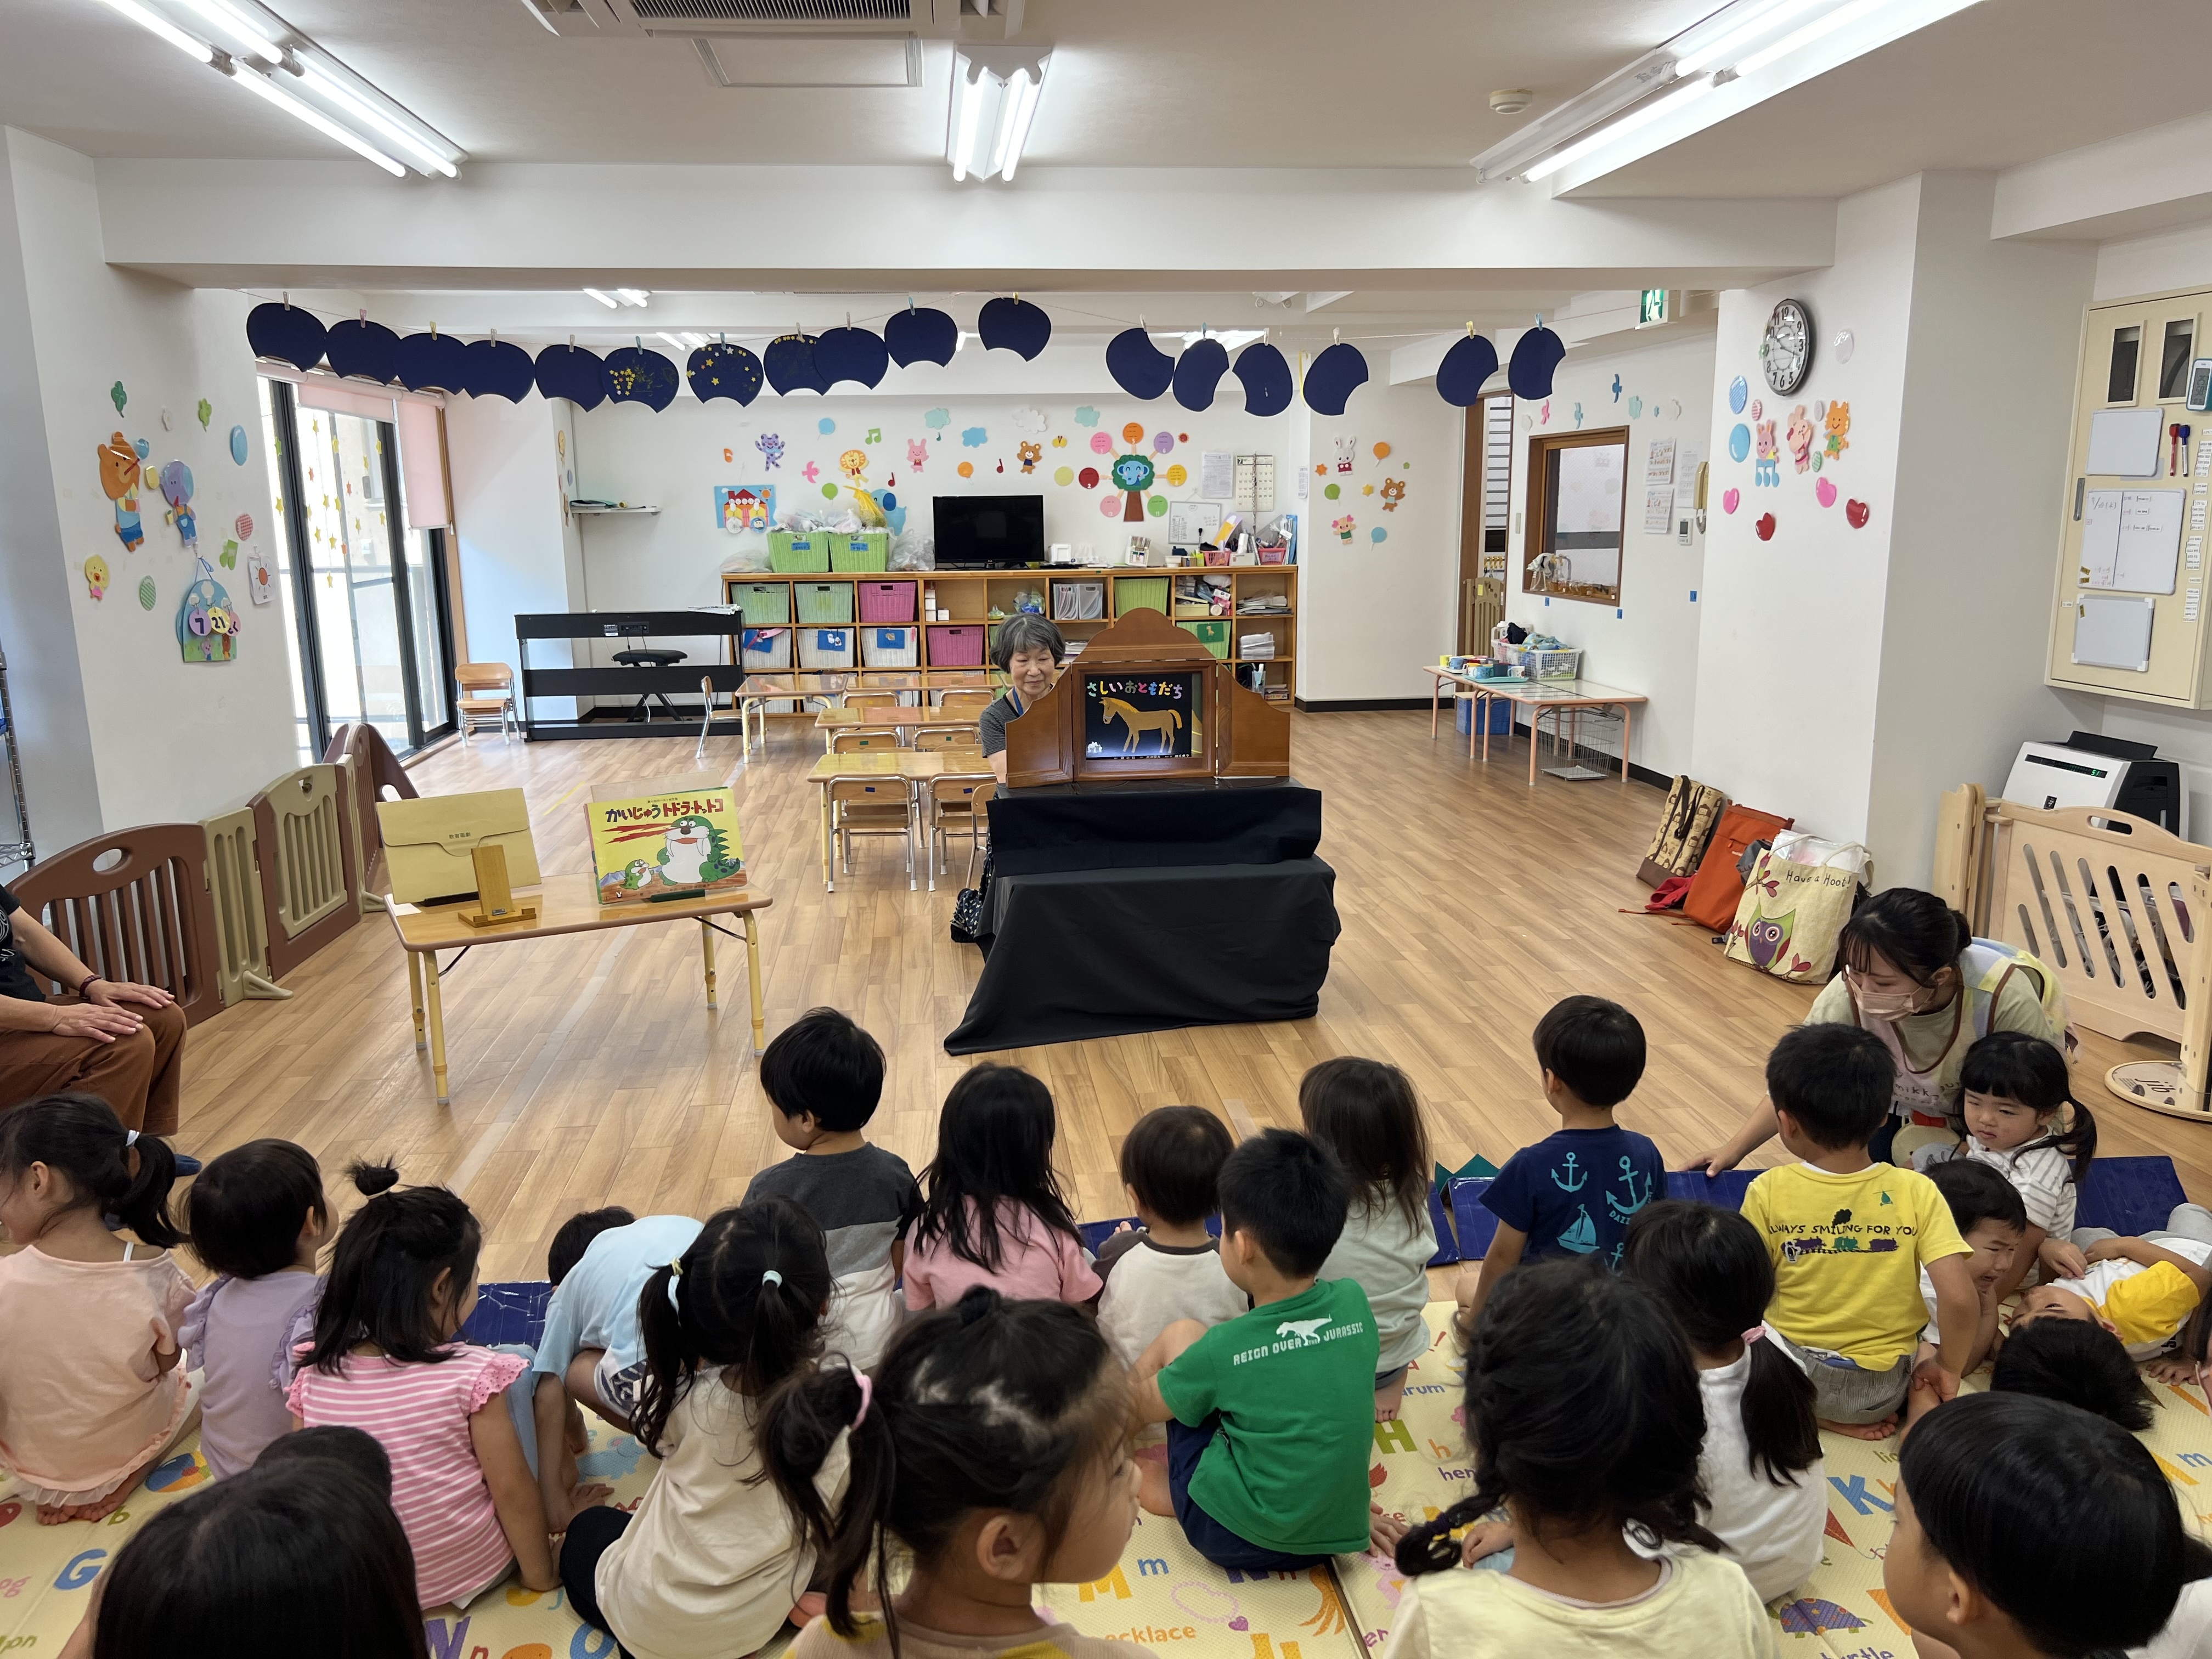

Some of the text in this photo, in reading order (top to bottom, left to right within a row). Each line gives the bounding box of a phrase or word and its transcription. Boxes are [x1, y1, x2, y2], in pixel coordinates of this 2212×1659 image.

[1781, 307, 1789, 320] 12
[1797, 321, 1802, 335] 2
[1798, 338, 1803, 352] 3
[1767, 360, 1771, 374] 8
[1796, 357, 1801, 371] 4
[1773, 372, 1778, 386] 7
[1780, 375, 1785, 388] 6
[1788, 371, 1793, 385] 5
[195, 617, 205, 634] 7
[211, 616, 226, 629] 21
[1086, 680, 1183, 699] さしいおともだち
[1786, 870, 1812, 883] Have
[1823, 873, 1851, 889] Hoot!
[1811, 1224, 1863, 1235] SMILING
[1866, 1225, 1891, 1235] FOR
[1895, 1226, 1918, 1237] YOU
[1233, 1345, 1268, 1365] REIGN
[1272, 1338, 1302, 1354] OVER
[1323, 1322, 1363, 1341] JURASSIC
[1374, 1419, 1418, 1455] H
[1427, 1438, 1452, 1459] h
[1826, 1474, 1895, 1516] K
[53, 1548, 108, 1590] G
[1137, 1557, 1169, 1577] m
